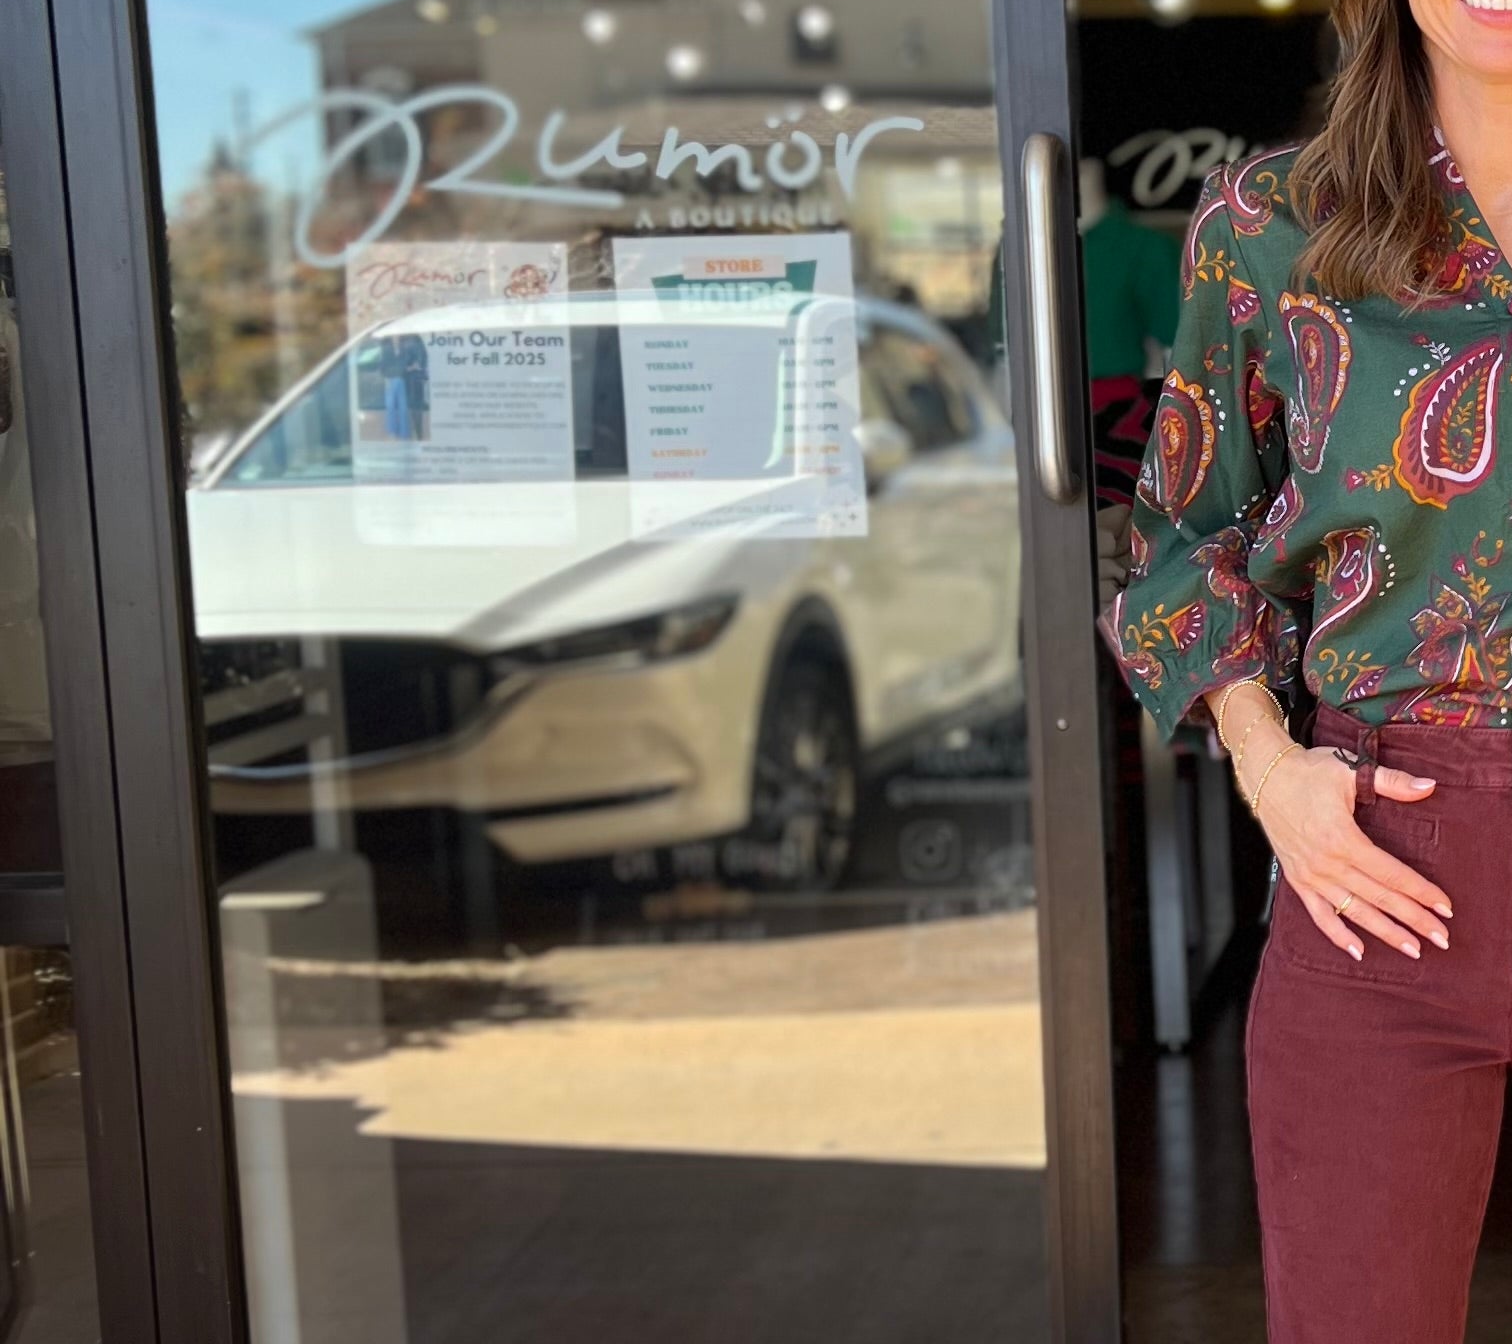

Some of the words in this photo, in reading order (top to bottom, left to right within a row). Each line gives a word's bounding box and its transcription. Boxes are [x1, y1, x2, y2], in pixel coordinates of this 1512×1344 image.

[635, 208, 655, 229] A
[668, 205, 837, 231] BOUTIQUE
[705, 259, 764, 274] STORE
[676, 280, 794, 313] HOURS
[427, 332, 464, 347] Join
[469, 332, 506, 347] Our
[511, 330, 564, 347] Team
[447, 352, 467, 365] for
[472, 352, 500, 365] Fall
[504, 352, 546, 365] 2025
[645, 361, 694, 371] TUESDAY
[648, 383, 713, 393] WEDNESDAY
[650, 427, 688, 436] FRIDAY
